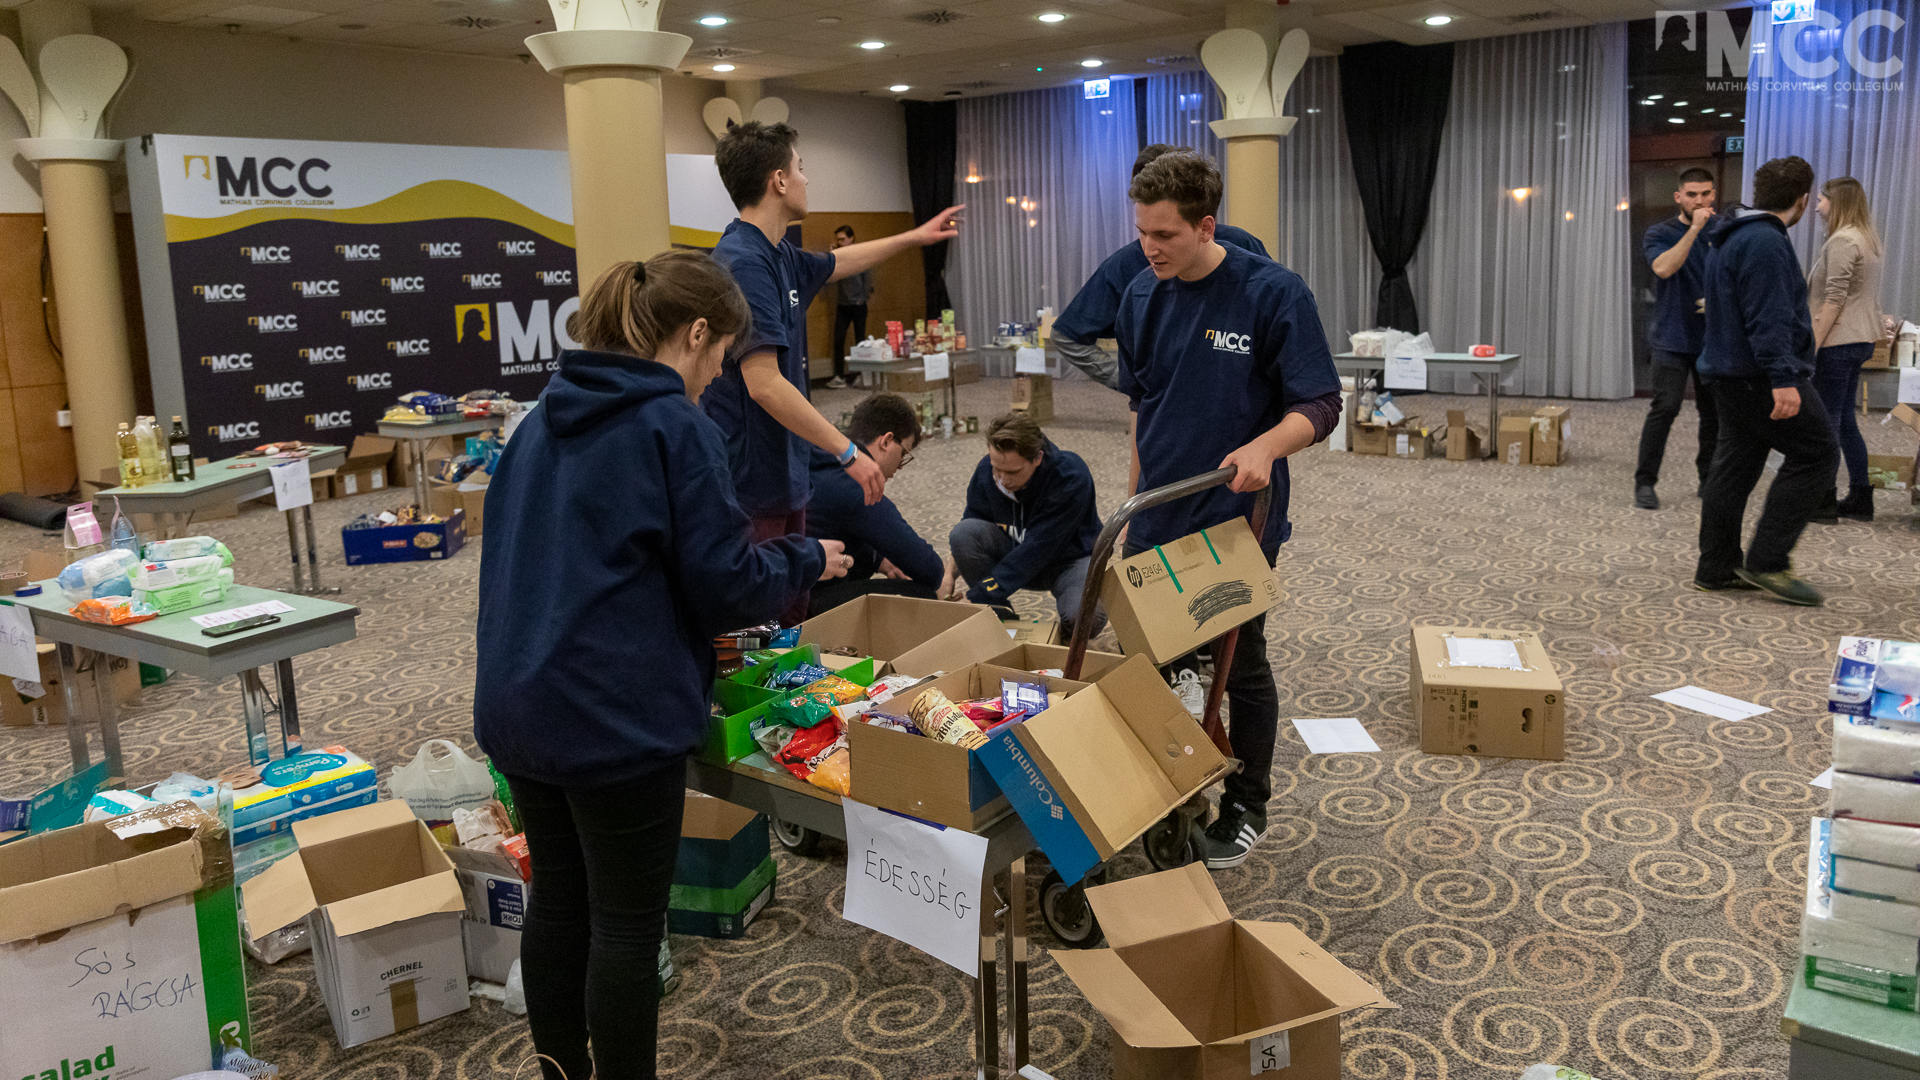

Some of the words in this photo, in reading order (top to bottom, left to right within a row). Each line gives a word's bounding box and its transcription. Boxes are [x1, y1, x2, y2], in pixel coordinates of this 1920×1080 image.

[1728, 139, 1743, 151] EX
[215, 156, 333, 198] MCC
[251, 246, 291, 261] MCC
[344, 244, 380, 259] MCC
[429, 242, 462, 256] MCC
[505, 241, 535, 254] MCC
[390, 276, 424, 291] MCC
[470, 273, 502, 287] MCC
[543, 270, 572, 284] MCC
[204, 284, 246, 300] MCC
[302, 280, 340, 295] MCC
[258, 314, 298, 330] MCC
[350, 309, 386, 324] MCC
[496, 296, 583, 364] MC
[396, 339, 430, 353] MCC
[1213, 330, 1251, 351] MCC
[211, 353, 253, 370] MCC
[309, 346, 346, 362] MCC
[501, 362, 543, 376] MATHIAS
[356, 372, 392, 388] MCC
[265, 381, 304, 398] MCC
[314, 410, 351, 428] MCC
[218, 421, 260, 440] MCC
[273, 757, 331, 776] Pampers
[1003, 735, 1053, 806] Columbia
[865, 838, 972, 919] ÉDESSÉG
[502, 912, 523, 924] TORK
[380, 961, 424, 981] CHERNEL
[91, 973, 197, 1019] RÁGCSA
[20, 1045, 116, 1080] alad
[1261, 1044, 1276, 1072] SA
